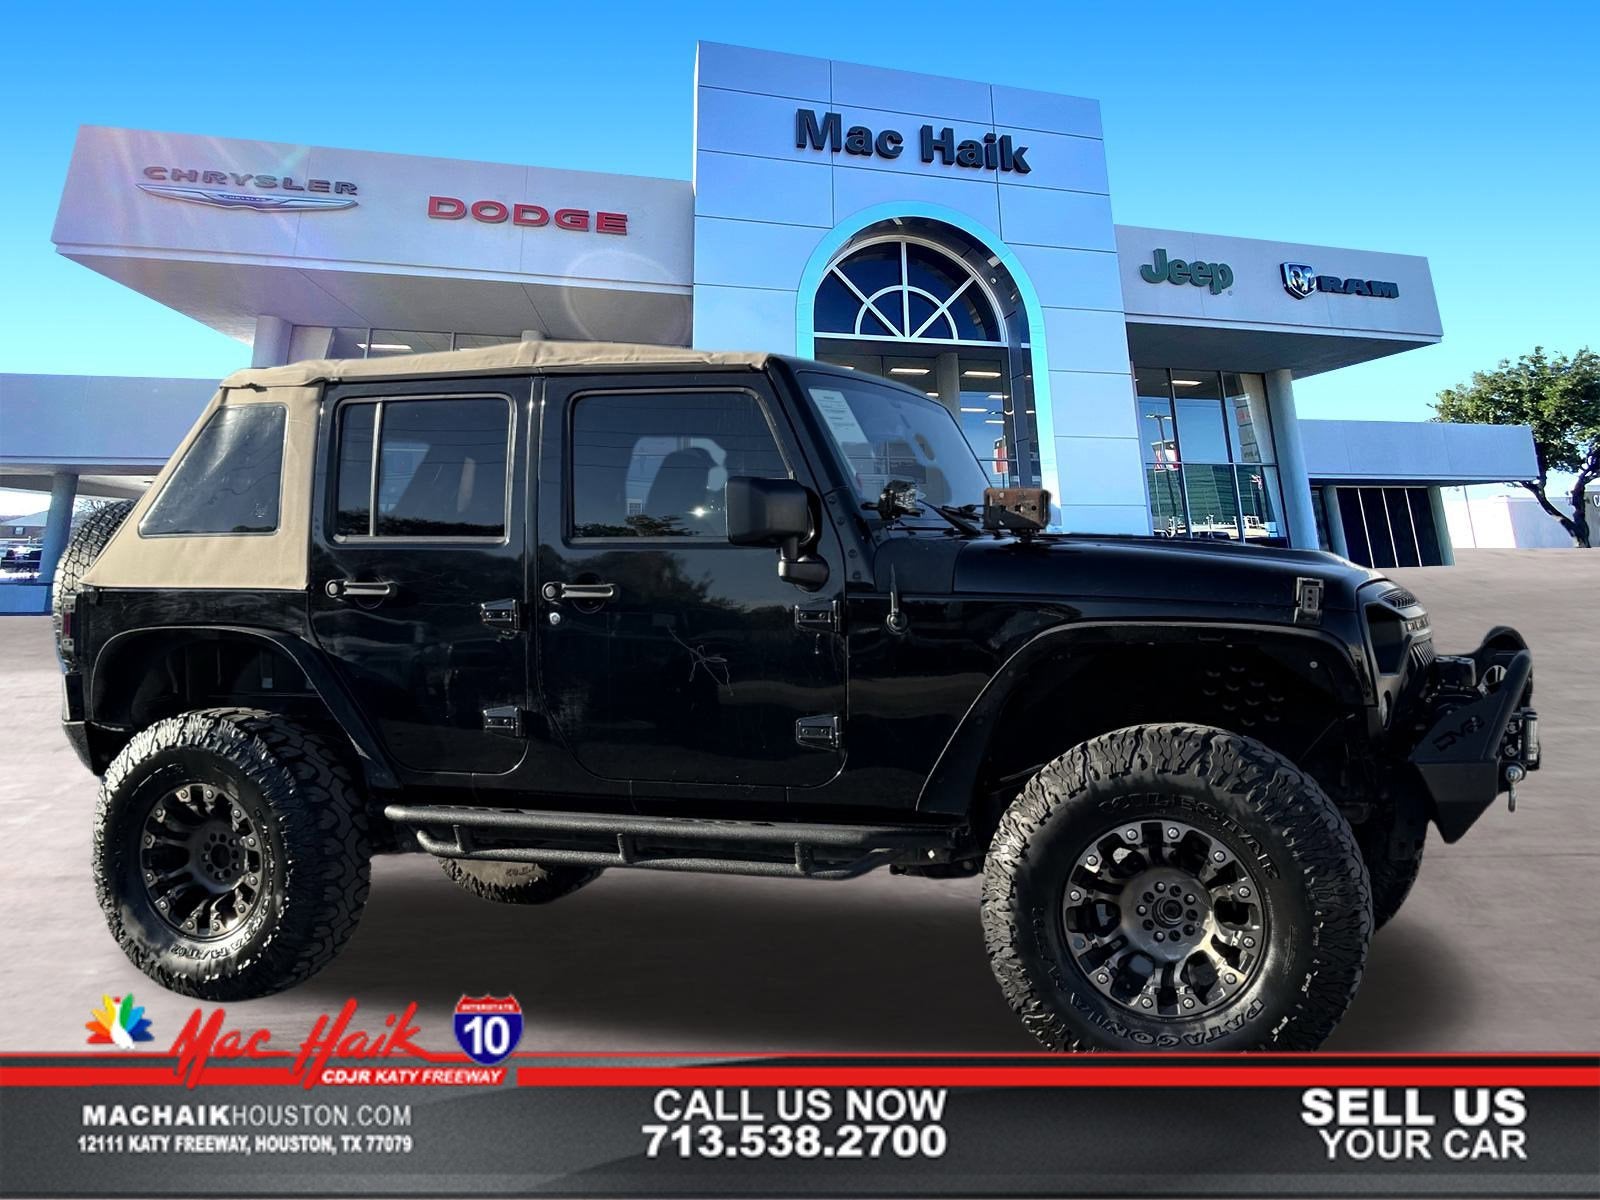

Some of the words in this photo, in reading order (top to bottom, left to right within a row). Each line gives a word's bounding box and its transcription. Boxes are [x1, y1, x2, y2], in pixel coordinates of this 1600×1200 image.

[795, 108, 904, 160] Mac
[919, 124, 1032, 174] Haik
[143, 166, 359, 196] CHRYSLER
[428, 195, 628, 236] DODGE
[1139, 248, 1234, 295] Jeep
[1316, 275, 1400, 299] RAM
[1070, 992, 1264, 1048] PATAGONIA
